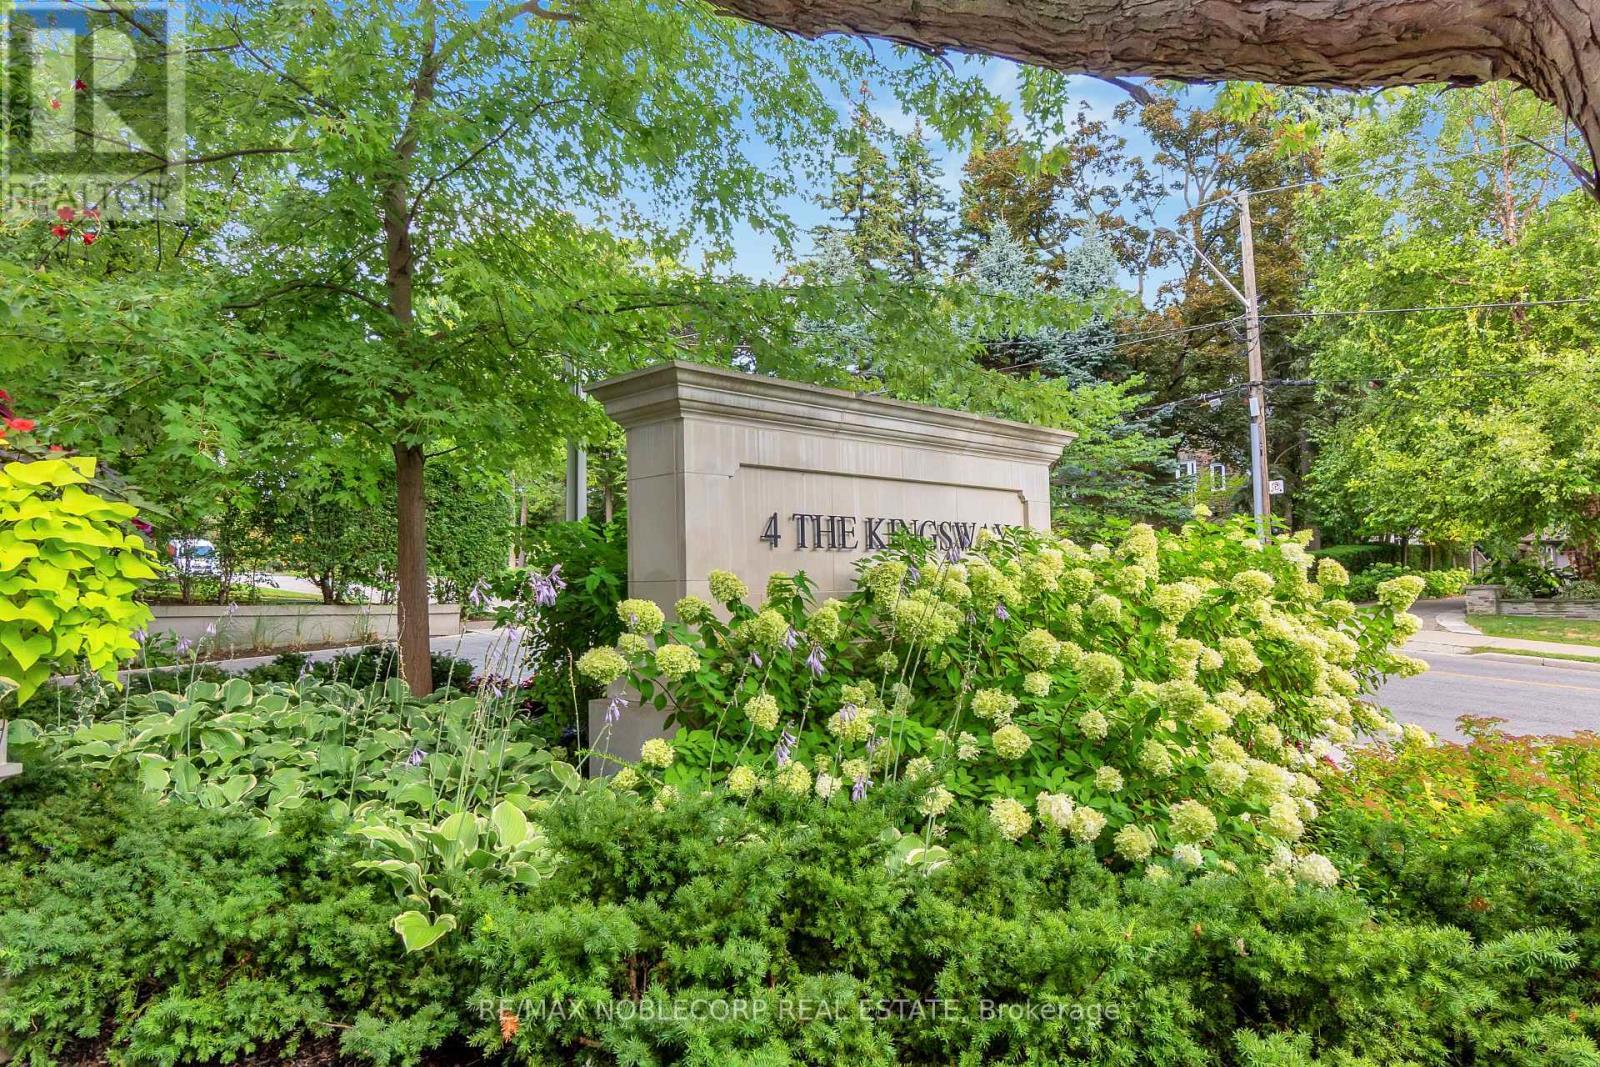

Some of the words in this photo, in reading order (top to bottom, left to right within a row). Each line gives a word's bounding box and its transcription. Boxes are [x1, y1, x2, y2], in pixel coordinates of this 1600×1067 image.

[760, 511, 781, 549] 4
[791, 513, 858, 550] THE
[865, 517, 1011, 552] KINGSWY
